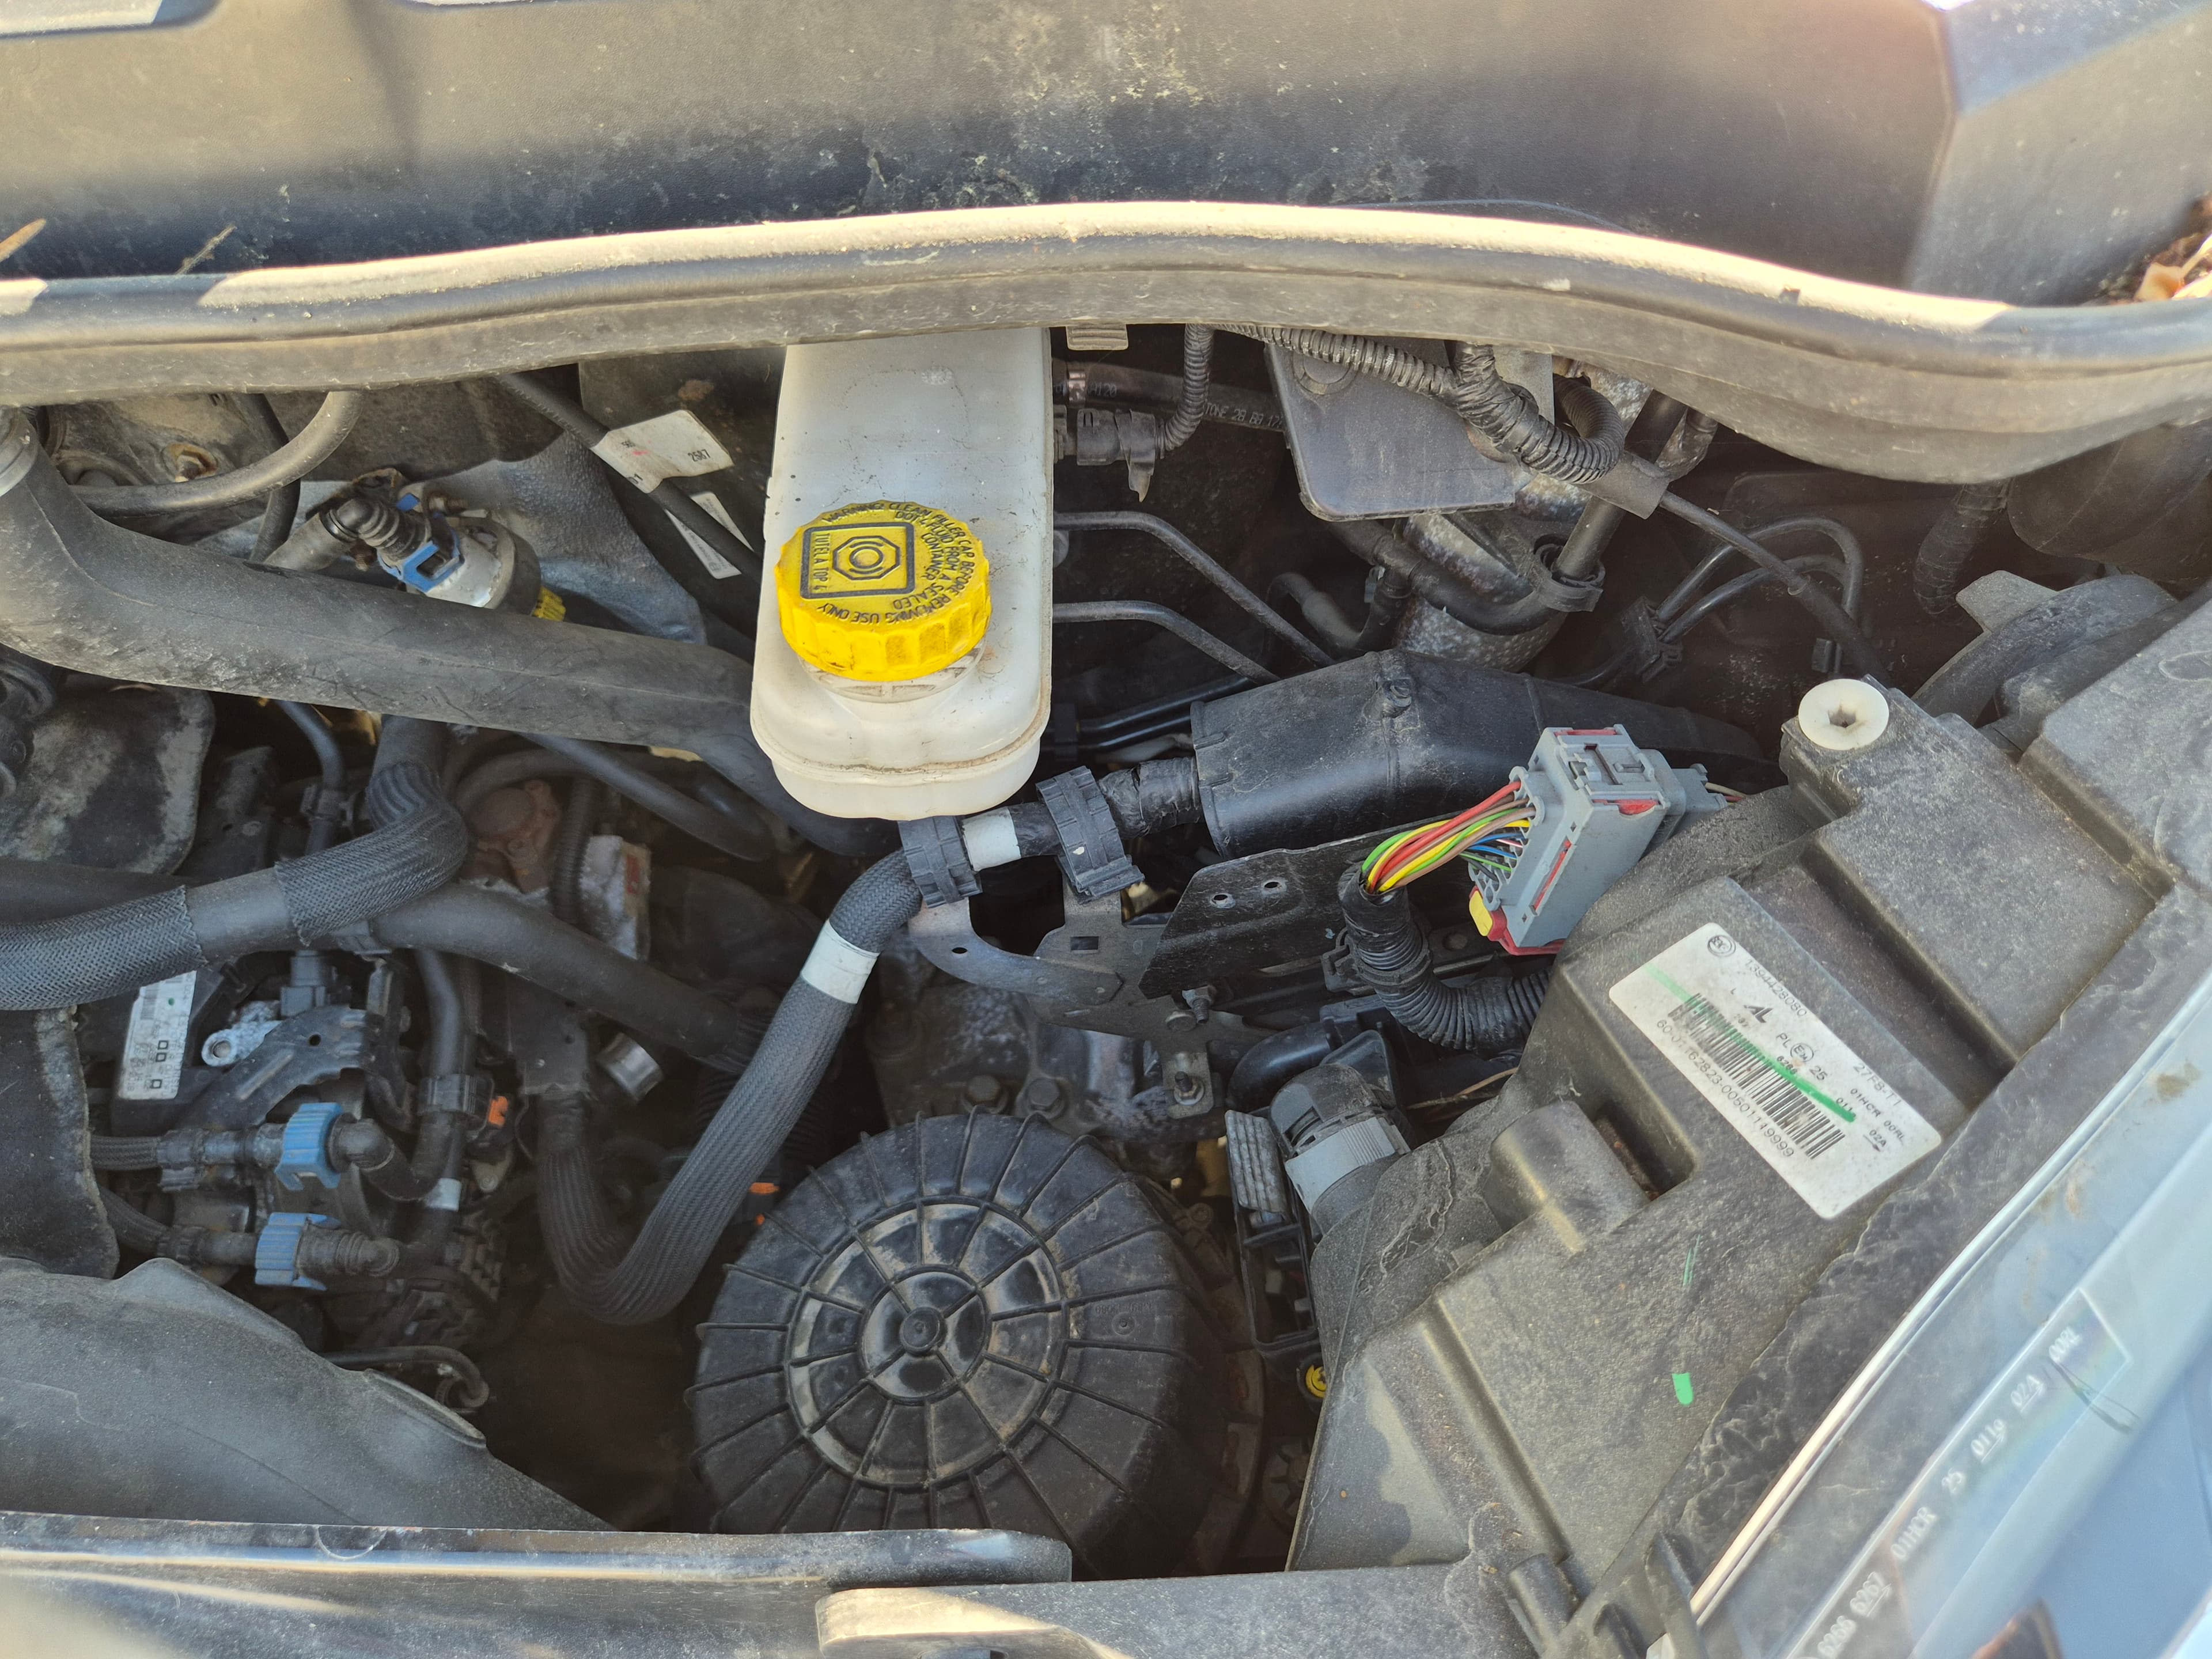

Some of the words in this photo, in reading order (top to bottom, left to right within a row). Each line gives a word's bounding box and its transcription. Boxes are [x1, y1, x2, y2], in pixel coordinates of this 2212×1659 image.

[889, 502, 933, 516] CLEAN
[925, 521, 955, 544] FLUID
[931, 514, 966, 538] FILLER
[813, 533, 830, 564] TUTELA
[920, 532, 945, 581] CONTAINER
[944, 546, 960, 571] FROM
[959, 540, 975, 558] CAP
[813, 567, 830, 582] TOP
[945, 560, 975, 596] BEFORE
[885, 593, 952, 624] REMOVING
[892, 582, 945, 610] SEALED
[816, 603, 850, 620] ONLY
[851, 611, 881, 624] USE
[1745, 959, 1807, 1017] 1394428080
[1775, 1032, 1791, 1048] PL
[1809, 1065, 1828, 1081] 25
[1850, 1088, 1881, 1118] 01HCR
[1869, 1129, 1887, 1147] 02A
